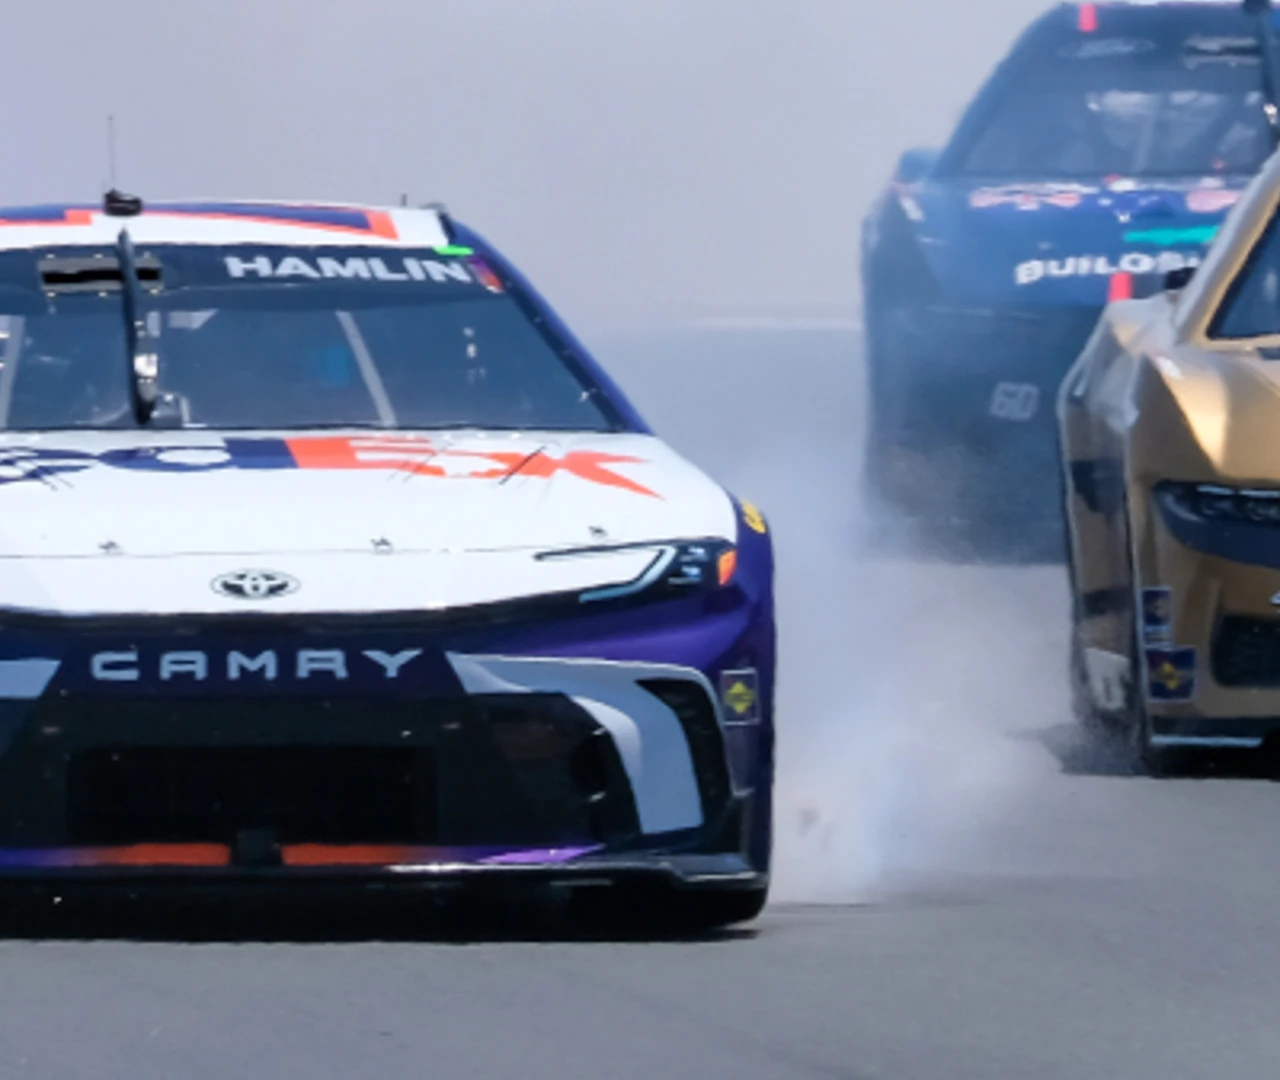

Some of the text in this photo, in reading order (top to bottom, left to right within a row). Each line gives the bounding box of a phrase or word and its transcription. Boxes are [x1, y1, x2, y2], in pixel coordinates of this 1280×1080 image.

[225, 255, 471, 283] HAMLIN
[989, 381, 1040, 420] 60
[91, 647, 423, 681] CAMRY
